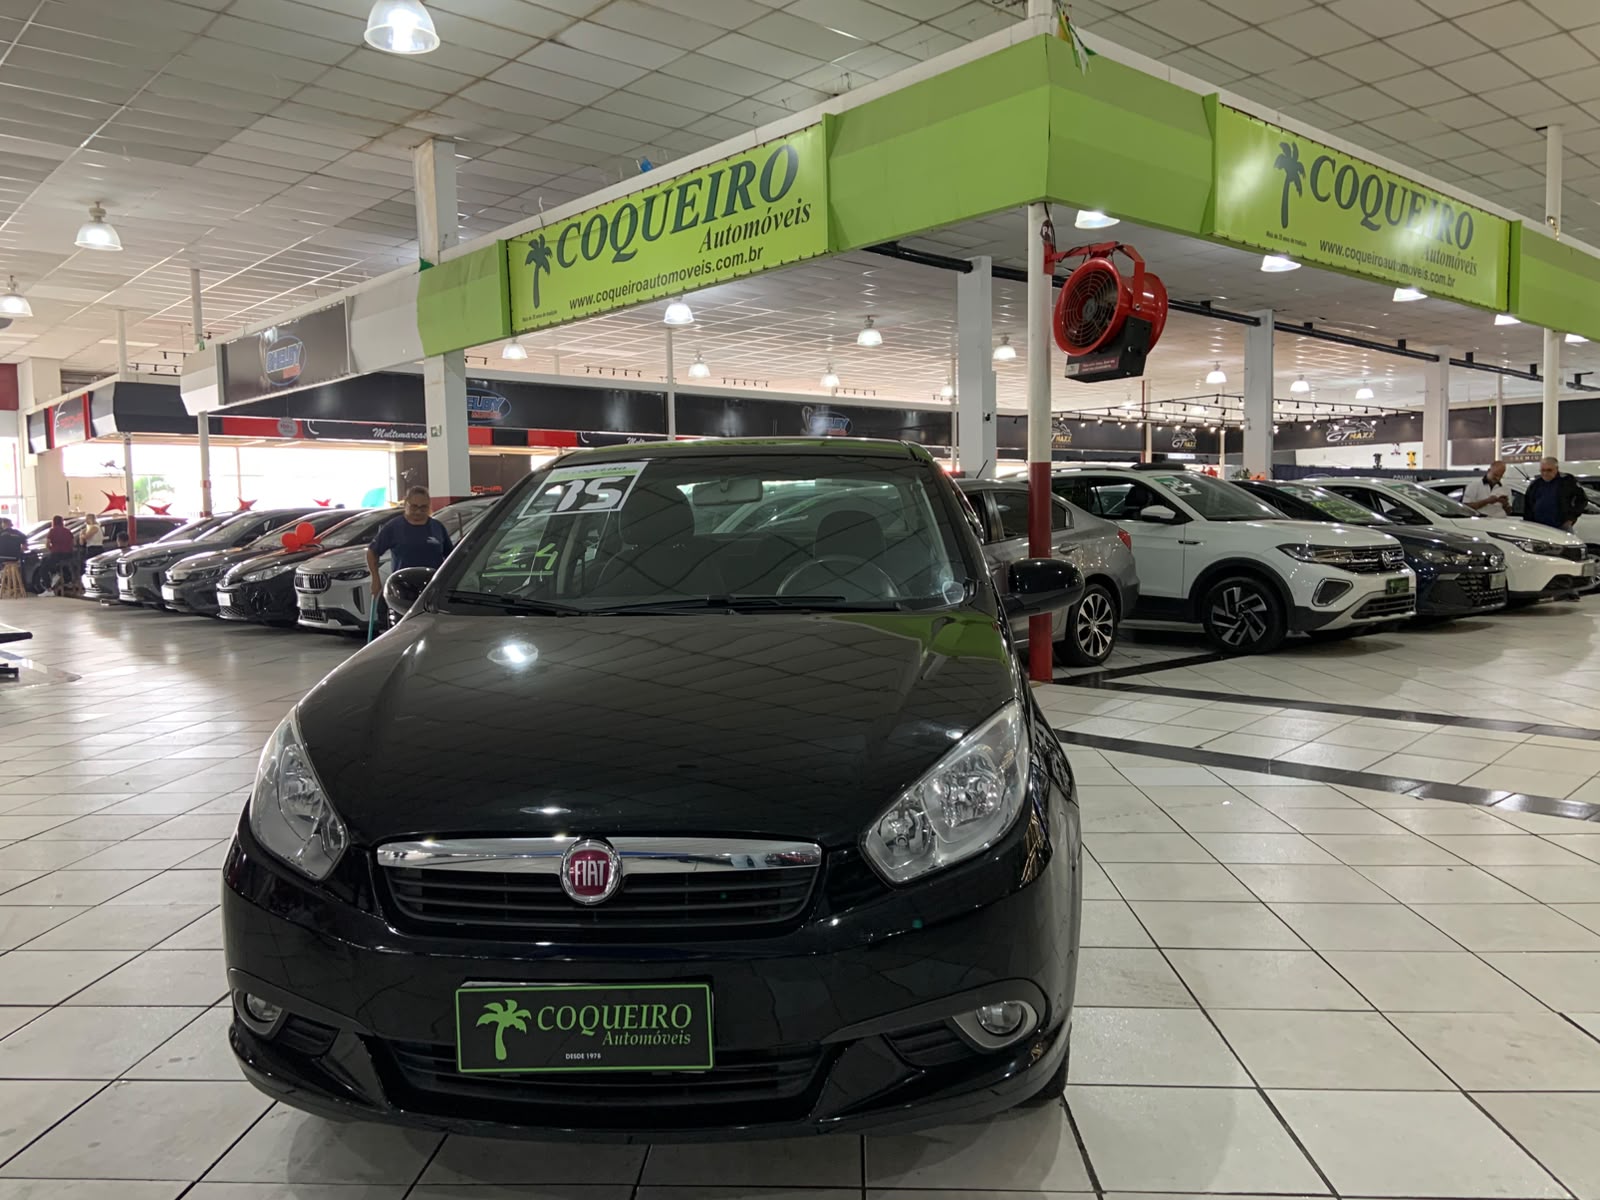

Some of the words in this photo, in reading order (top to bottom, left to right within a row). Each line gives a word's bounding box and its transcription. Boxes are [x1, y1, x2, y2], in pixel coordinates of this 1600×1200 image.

[556, 144, 798, 268] COQUEIRO
[1309, 155, 1474, 250] COQUEIRO
[698, 197, 812, 253] Automóveis
[1318, 239, 1456, 288] www.coqueiroautomoveis.com.br
[1421, 245, 1478, 276] Automóveis
[569, 246, 764, 310] www.coqueiroautomoveis.com.br
[467, 395, 505, 412] ELBY
[1501, 442, 1534, 456] GT
[1525, 444, 1543, 454] MA
[556, 476, 623, 512] 15
[497, 543, 559, 570] 1.4
[574, 860, 607, 887] FIAT
[537, 1003, 693, 1037] COQUEIRO
[602, 1029, 692, 1046] Automóveis
